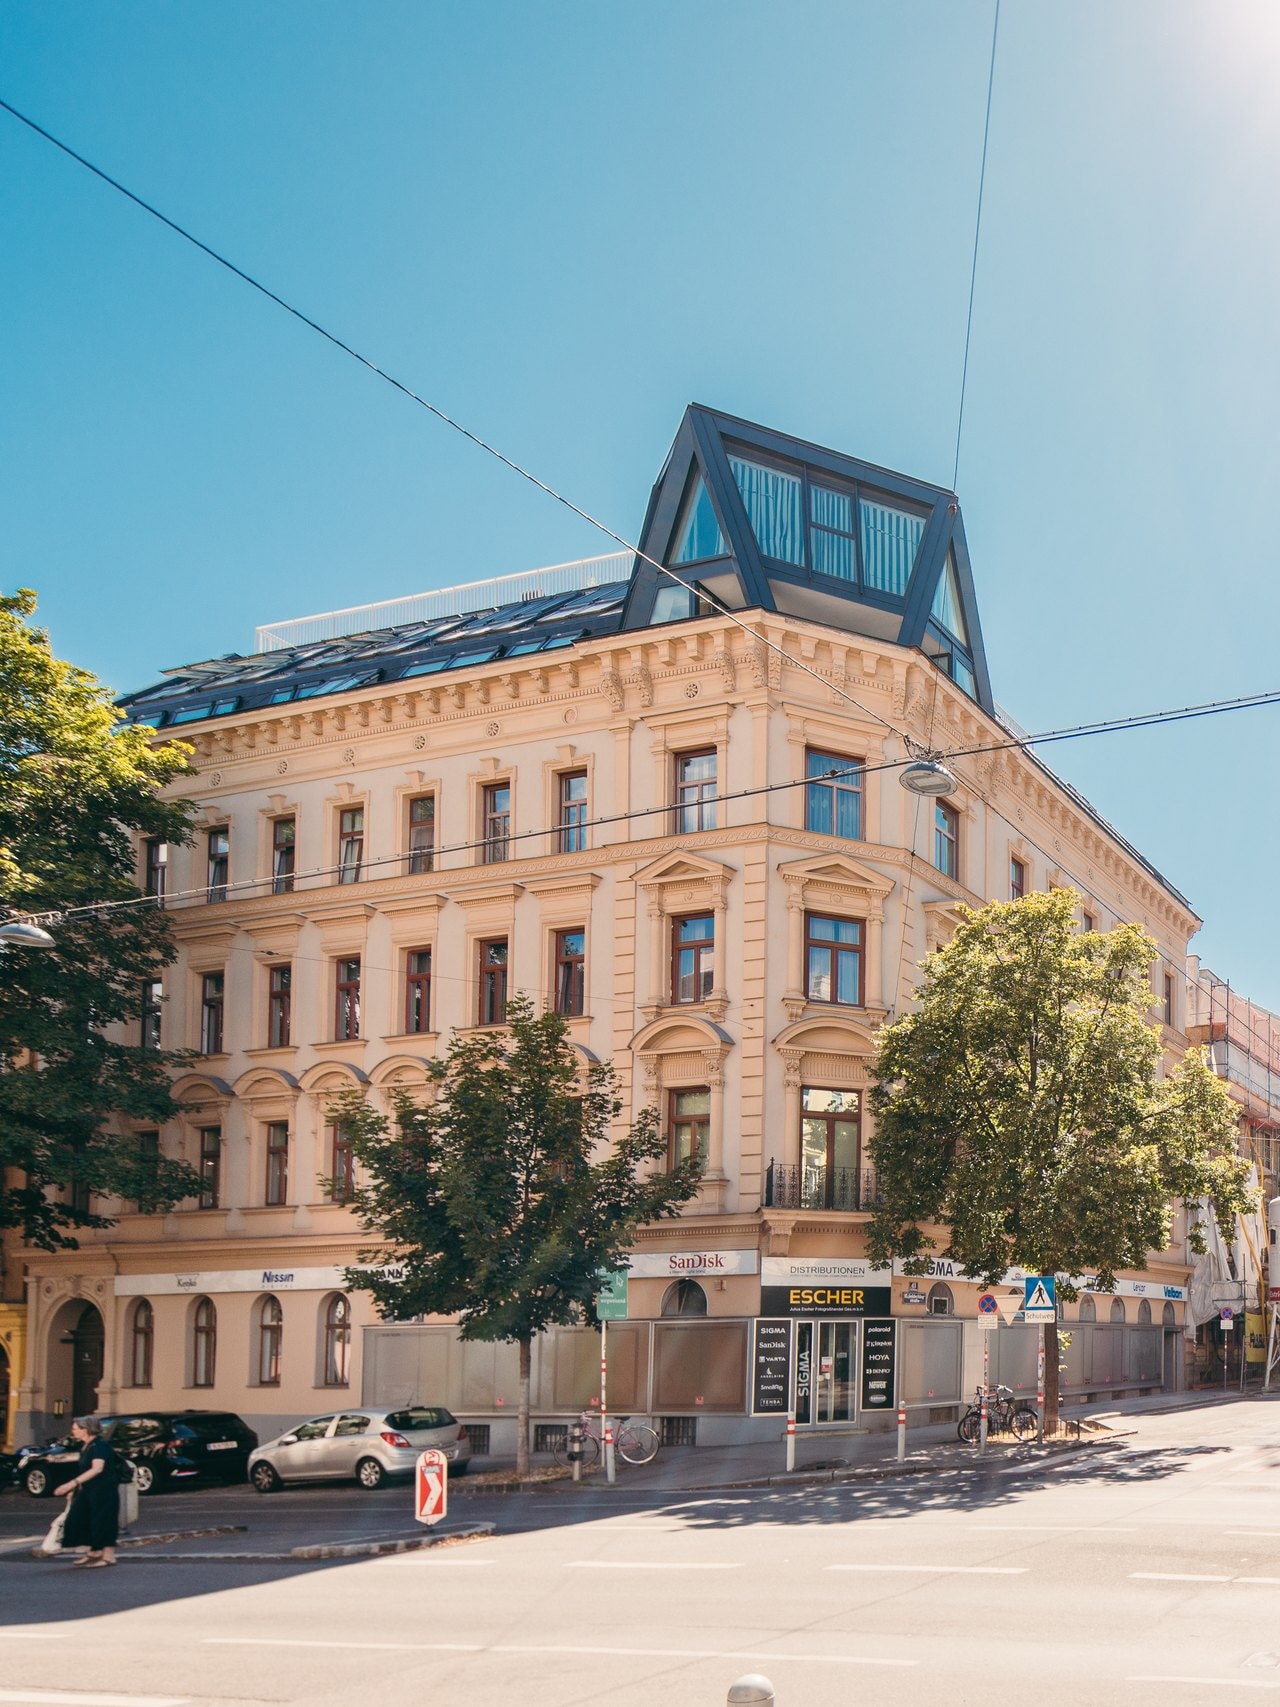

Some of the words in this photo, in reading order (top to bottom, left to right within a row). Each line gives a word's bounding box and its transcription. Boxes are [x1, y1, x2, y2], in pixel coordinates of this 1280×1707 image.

[669, 1254, 724, 1269] SanDisk
[790, 1266, 865, 1275] DISTRIBUTIONEN
[1163, 1285, 1183, 1299] Velbon
[790, 1289, 864, 1305] ESCHER
[1026, 1312, 1055, 1321] Schulweg
[760, 1327, 786, 1335] SIGMA
[867, 1326, 892, 1334] polaroid
[759, 1341, 786, 1349] SanDisk
[798, 1351, 810, 1397] SIGMA
